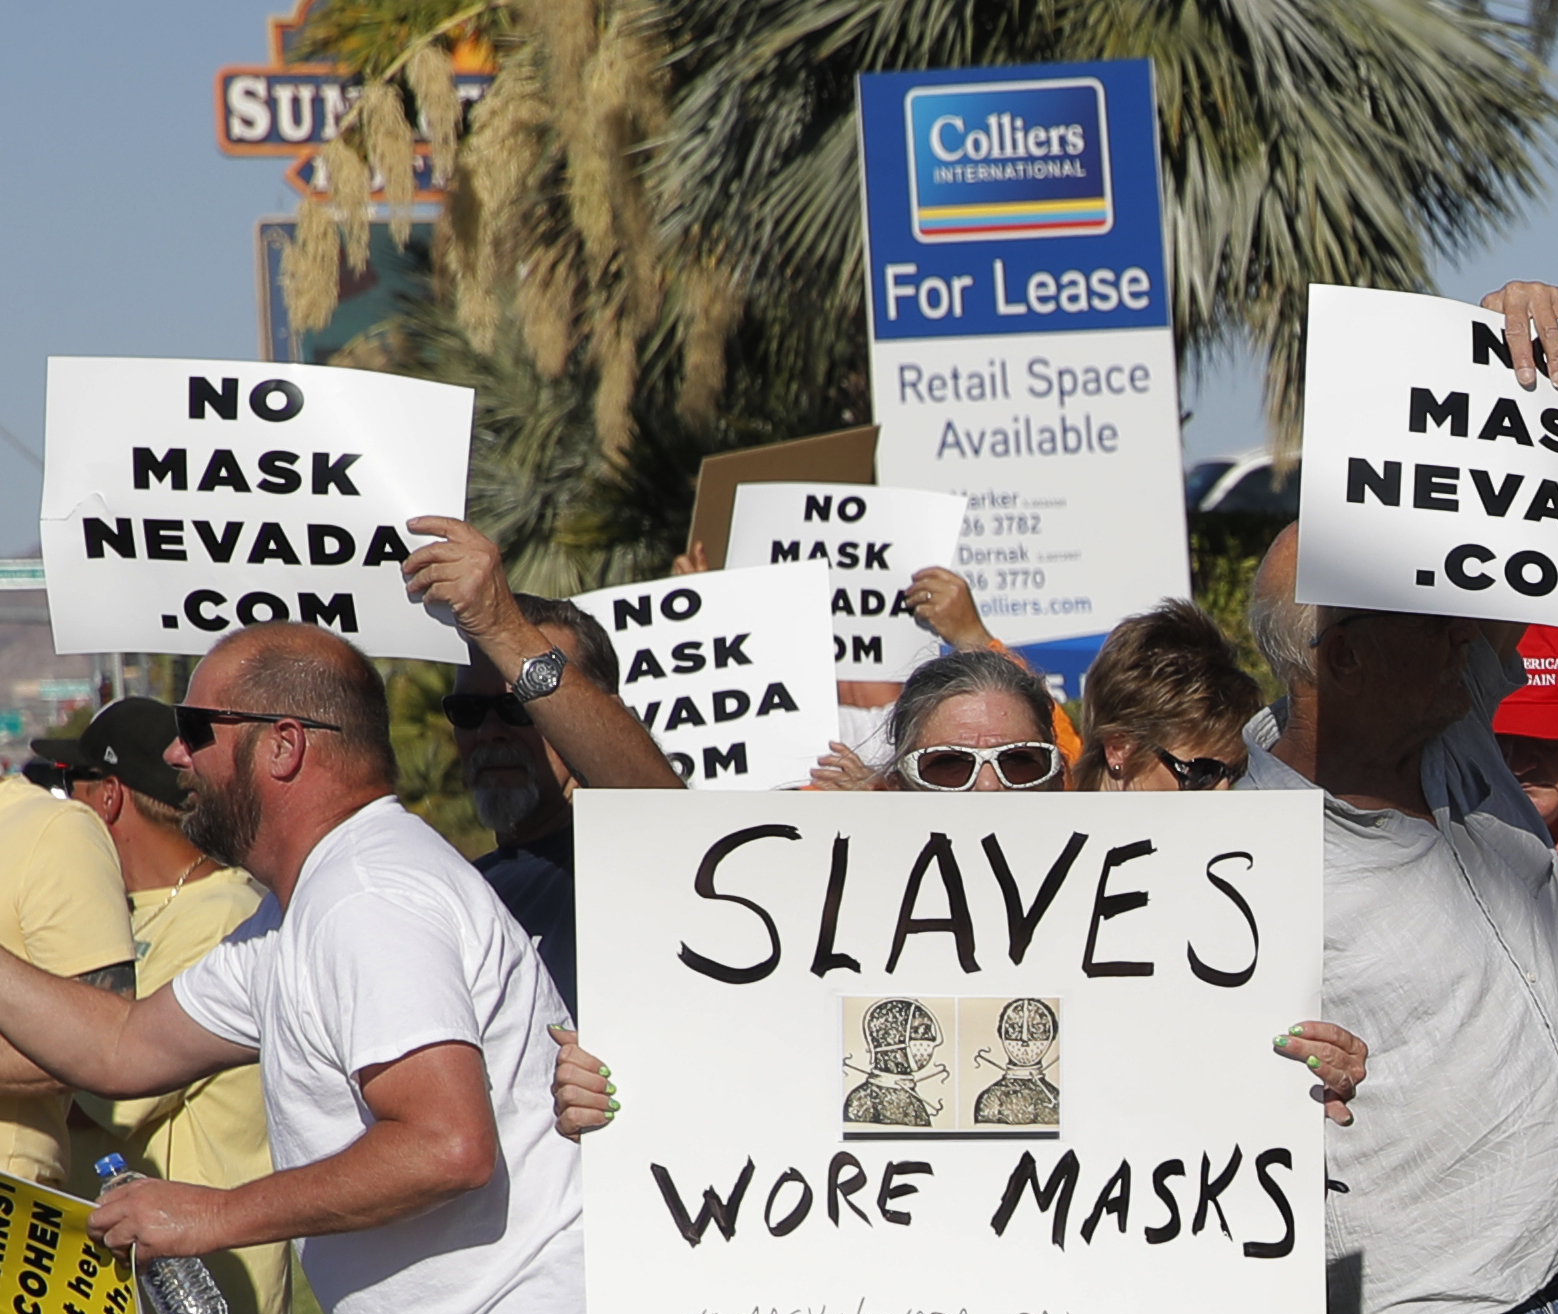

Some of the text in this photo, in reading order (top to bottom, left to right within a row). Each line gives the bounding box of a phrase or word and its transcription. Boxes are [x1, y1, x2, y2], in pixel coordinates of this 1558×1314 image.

[929, 112, 1086, 164] Colliers
[933, 158, 1087, 185] INTERNATIONAL
[884, 258, 1151, 321] For Lease
[188, 376, 305, 423] NO
[898, 355, 1152, 407] Retail Space
[936, 414, 1119, 460] Available
[132, 448, 362, 497] MASK
[803, 494, 867, 523] NO
[84, 517, 411, 567] NEVADA
[770, 540, 894, 571] MASK
[958, 542, 1030, 566] Dornak
[996, 566, 1047, 592] 3770
[161, 589, 360, 633] .COM
[612, 588, 702, 631] NO
[625, 633, 753, 684] ASK
[677, 824, 1260, 988] SLAVES
[649, 1144, 1294, 1259] WORE MASKS
[67, 1243, 101, 1300] her
